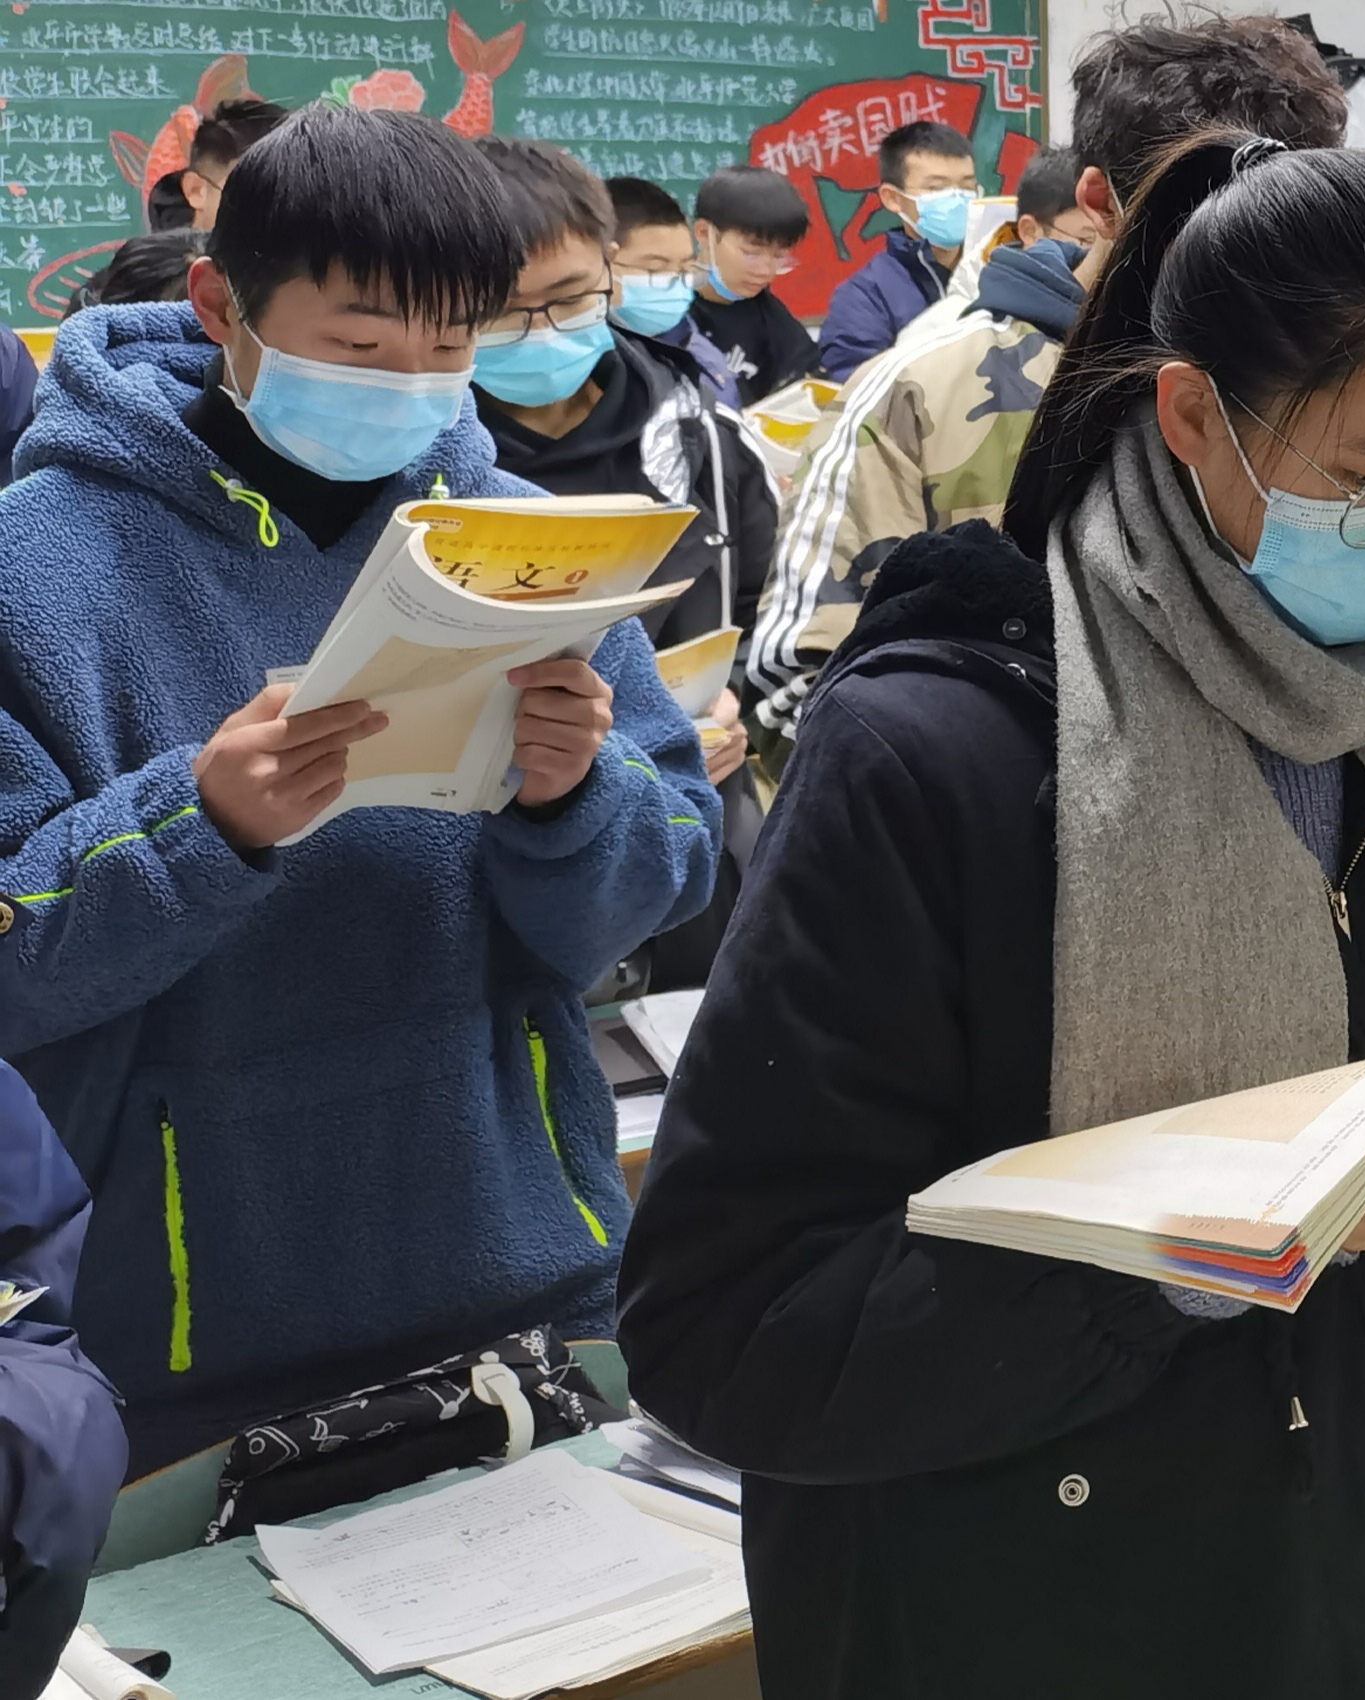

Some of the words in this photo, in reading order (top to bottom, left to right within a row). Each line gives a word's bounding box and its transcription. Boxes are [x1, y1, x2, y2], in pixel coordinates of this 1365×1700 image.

[758, 83, 947, 176] 打倒卖国贼
